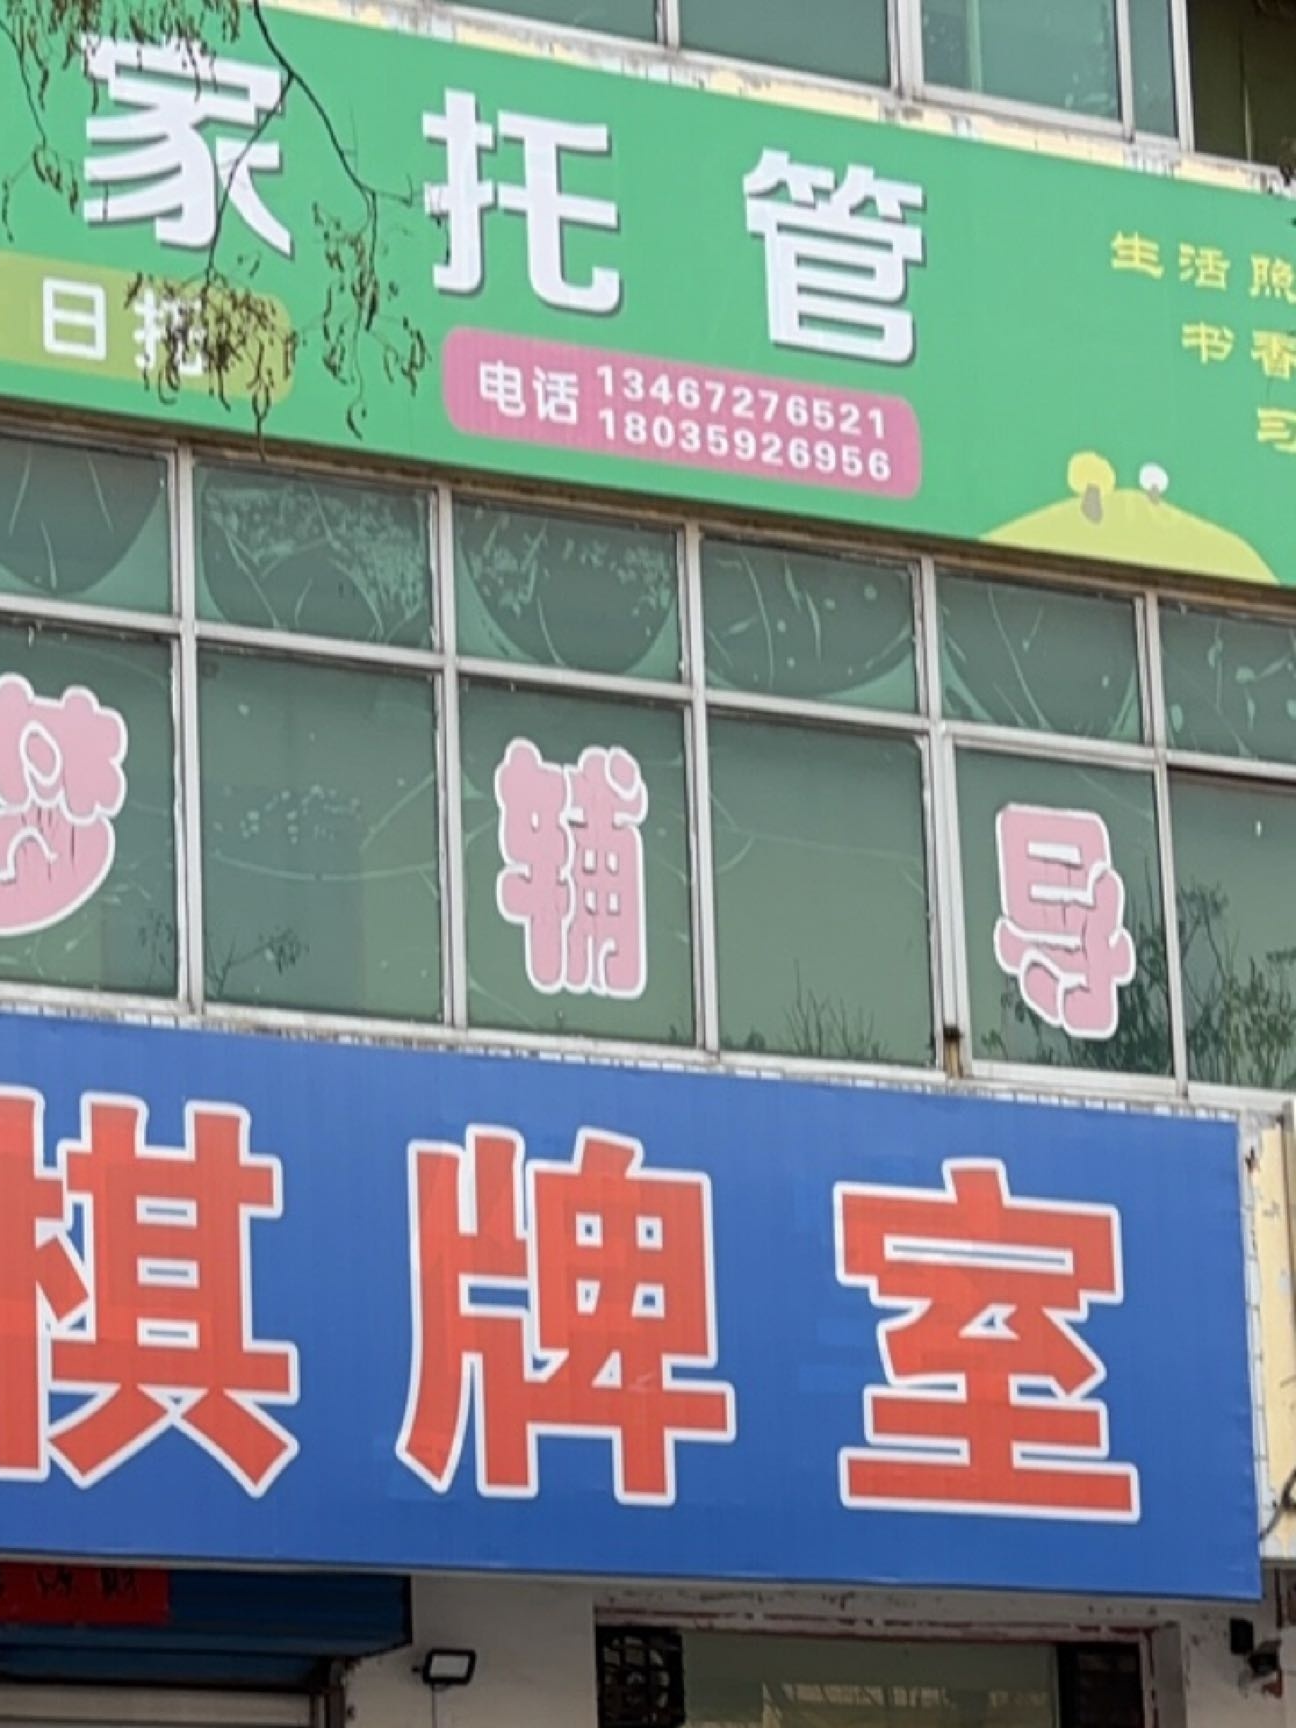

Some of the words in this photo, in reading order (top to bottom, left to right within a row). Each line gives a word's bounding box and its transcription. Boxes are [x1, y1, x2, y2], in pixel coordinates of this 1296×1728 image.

[478, 360, 579, 425] 电话
[596, 365, 886, 440] 13467276521
[599, 408, 892, 482] 18035926956
